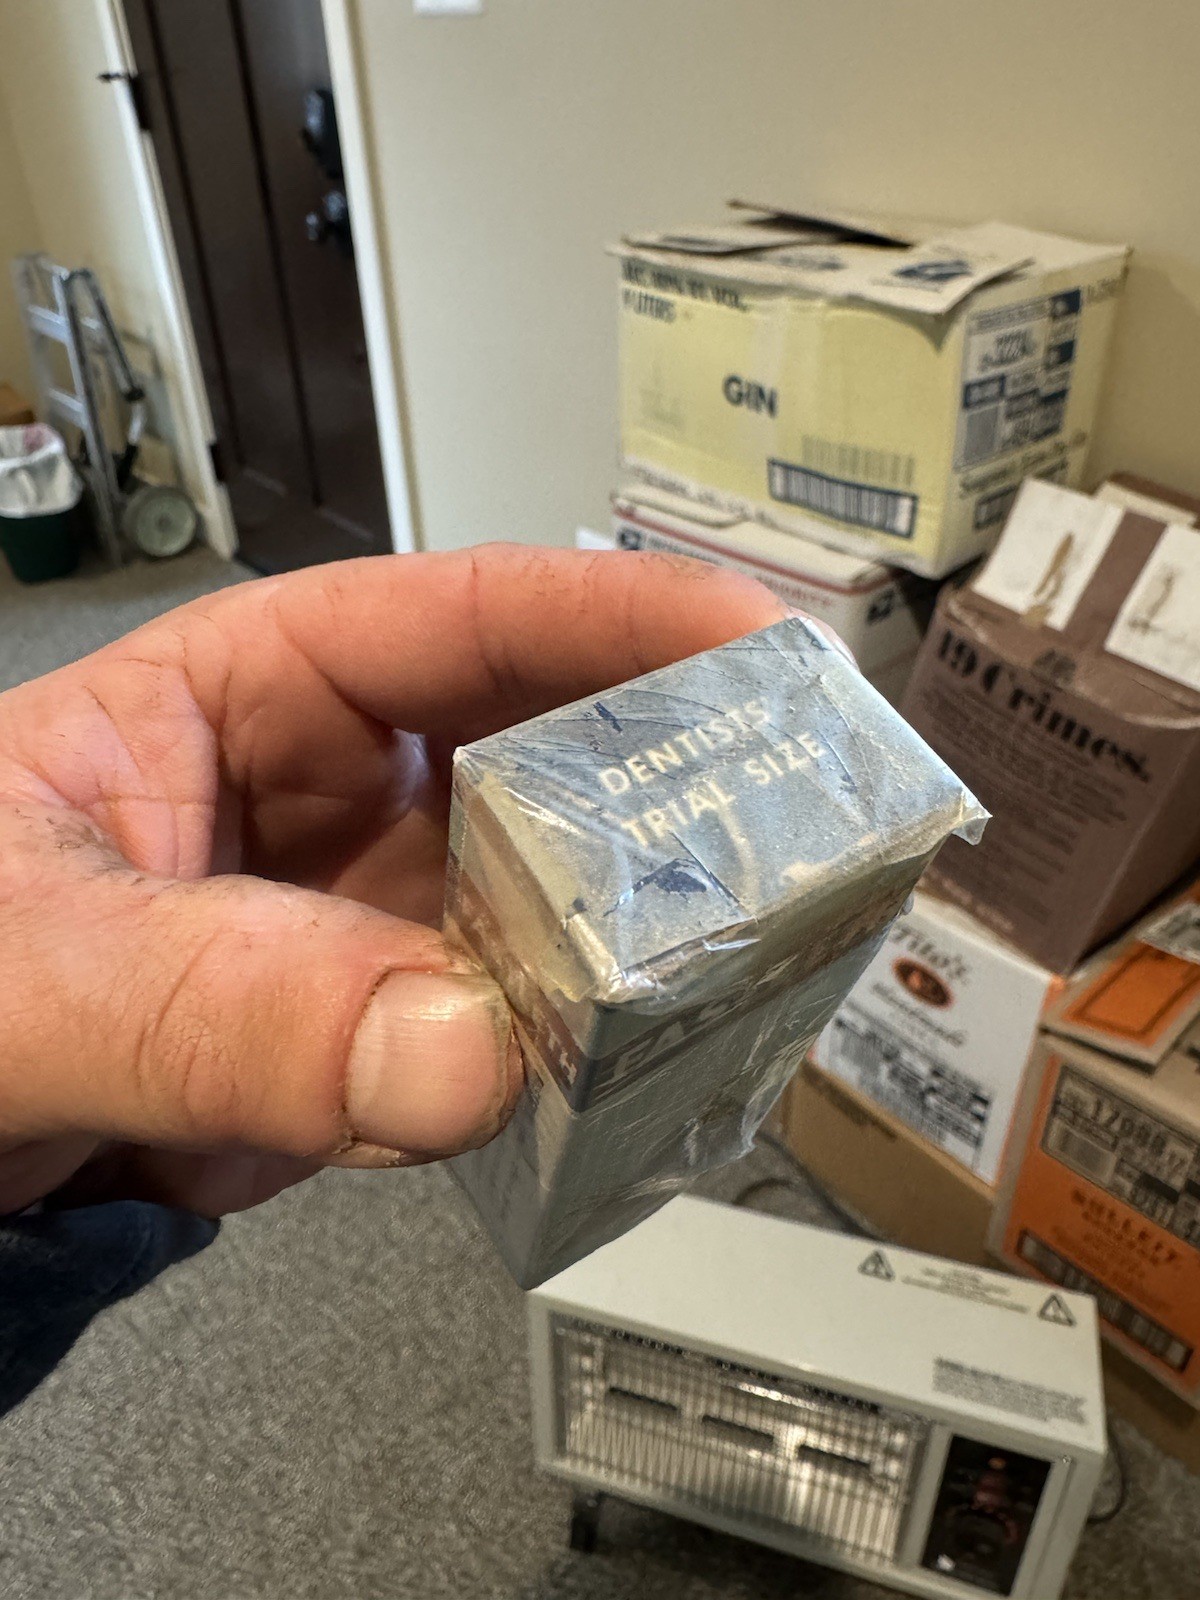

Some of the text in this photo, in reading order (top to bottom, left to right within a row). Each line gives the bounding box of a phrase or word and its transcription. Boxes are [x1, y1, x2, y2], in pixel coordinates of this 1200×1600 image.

[722, 375, 779, 419] GIN
[938, 630, 977, 678] 19
[621, 731, 826, 848] TRIAL SIZE
